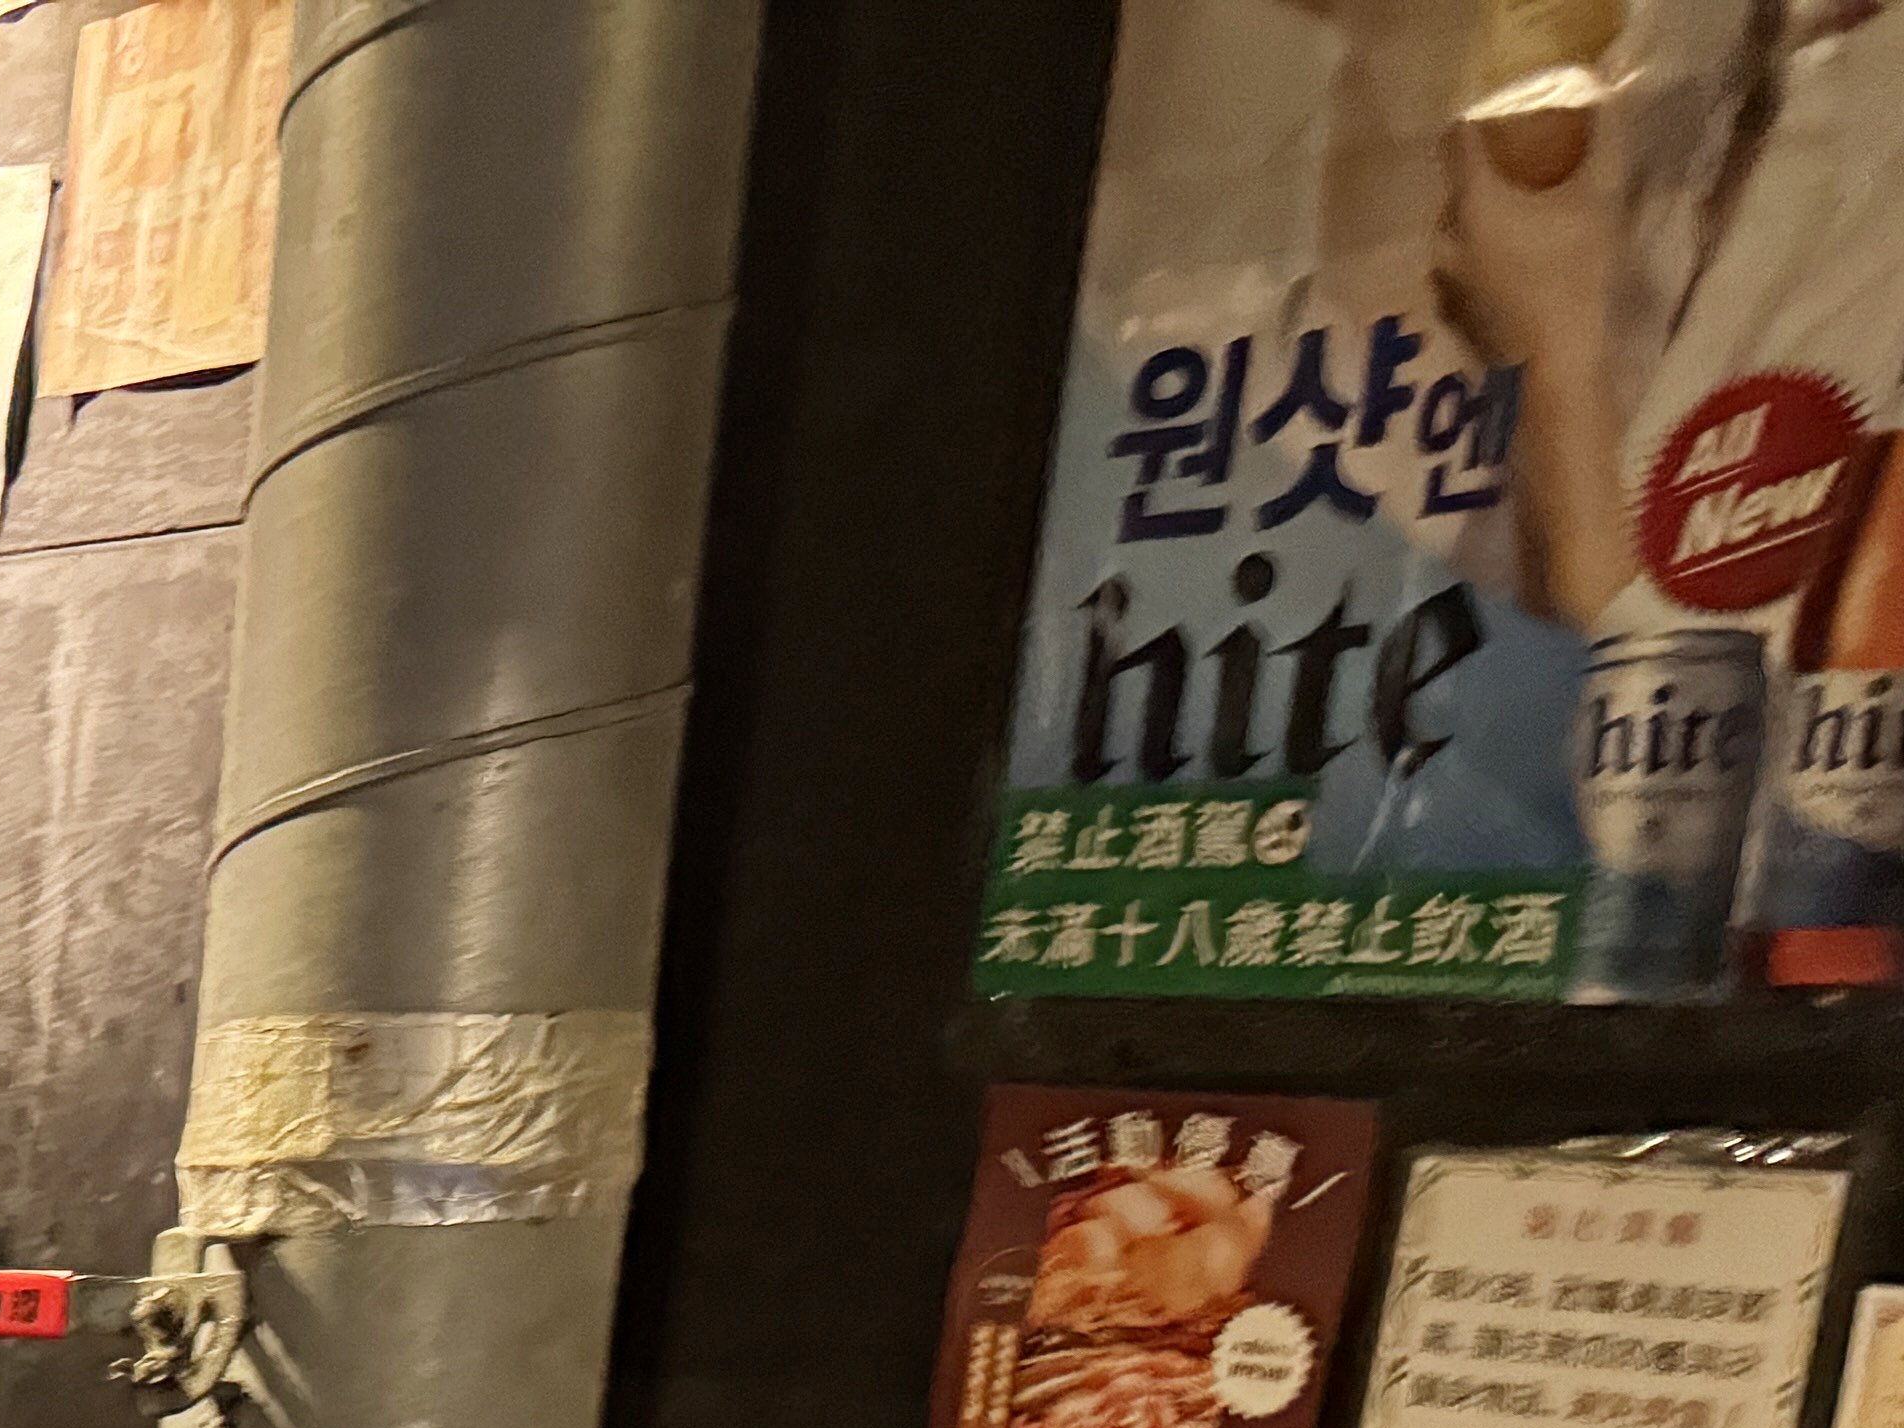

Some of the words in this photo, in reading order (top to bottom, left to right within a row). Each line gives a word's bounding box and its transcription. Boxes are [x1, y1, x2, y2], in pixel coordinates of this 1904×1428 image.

[1106, 314, 1526, 544] 원샷엔
[1070, 552, 1484, 785] hite
[1798, 672, 1904, 774] hi
